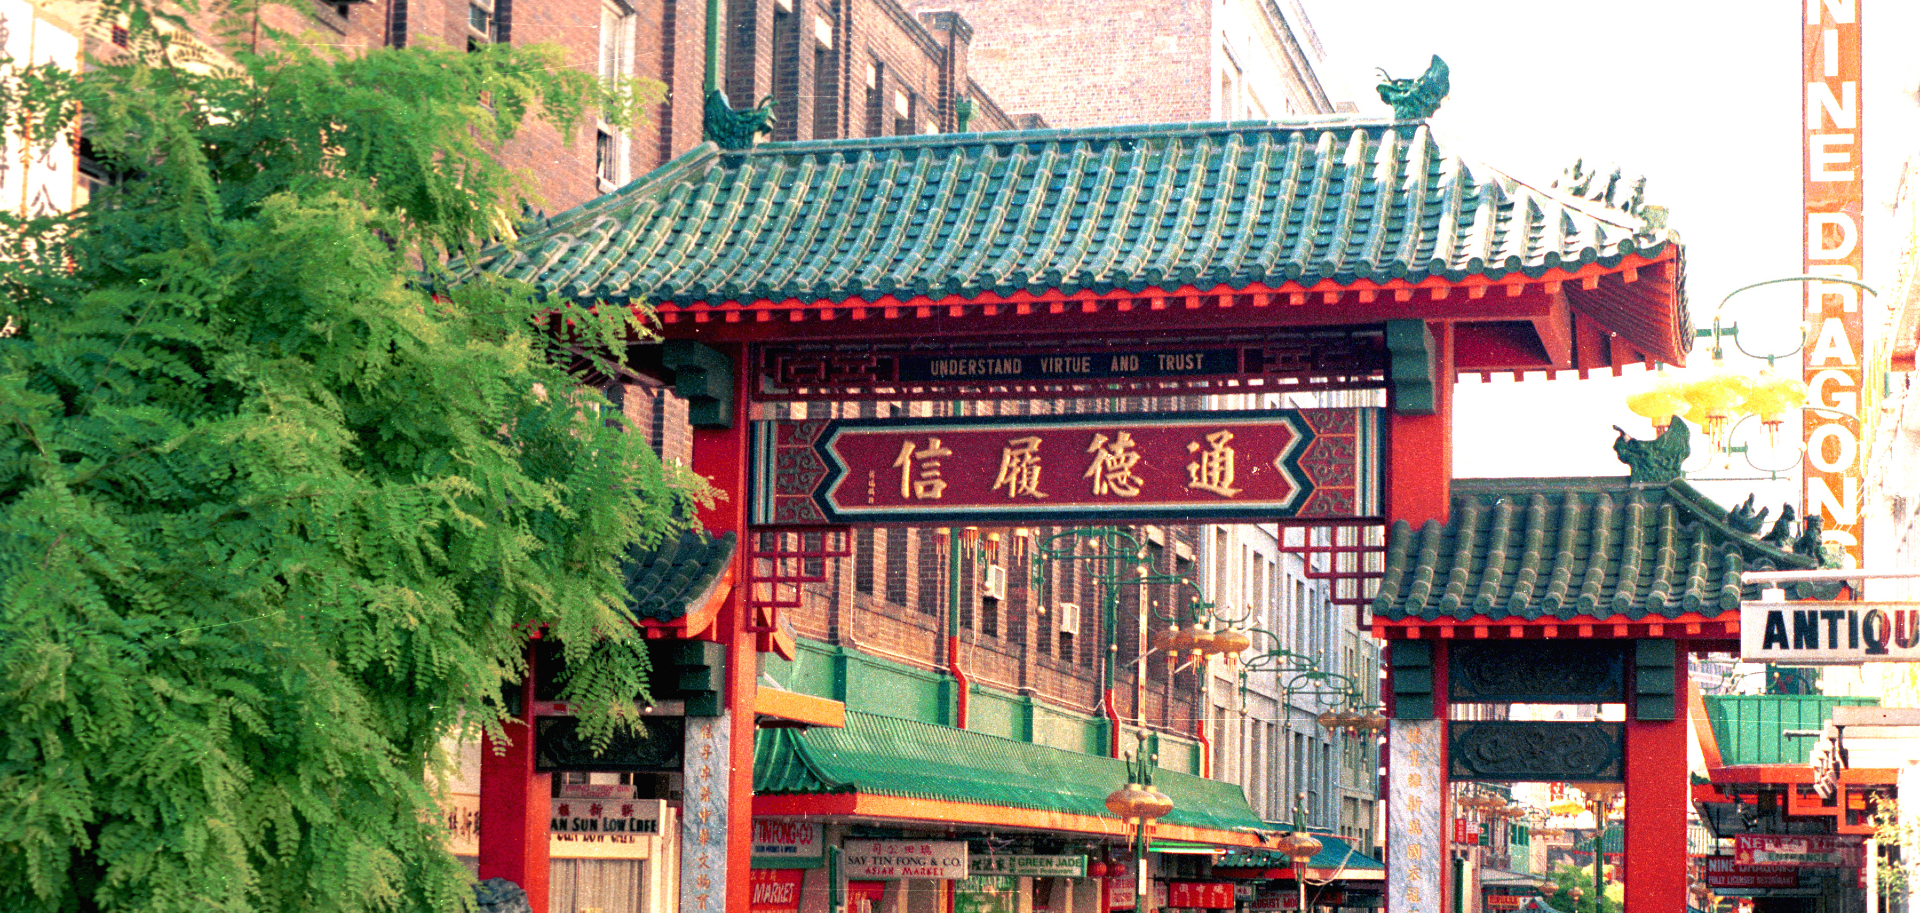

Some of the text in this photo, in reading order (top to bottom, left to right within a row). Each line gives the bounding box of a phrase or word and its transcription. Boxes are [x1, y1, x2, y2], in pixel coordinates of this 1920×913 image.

[931, 353, 1204, 376] UNDERSTAND VIRTUE AND TRUST
[1762, 608, 1920, 655] ANTIQU
[572, 817, 598, 831] SUN
[603, 817, 626, 832] LOW
[629, 817, 657, 833] CAFE
[848, 856, 866, 865] SAY
[872, 856, 892, 865] TIN
[896, 856, 926, 866] FONG
[930, 857, 938, 866] &
[1018, 856, 1054, 867] GREEN
[1055, 857, 1081, 868] JADE
[1708, 859, 1735, 872] NINE
[865, 867, 945, 876] ASIAN MARKET
[752, 882, 795, 904] MARKET
